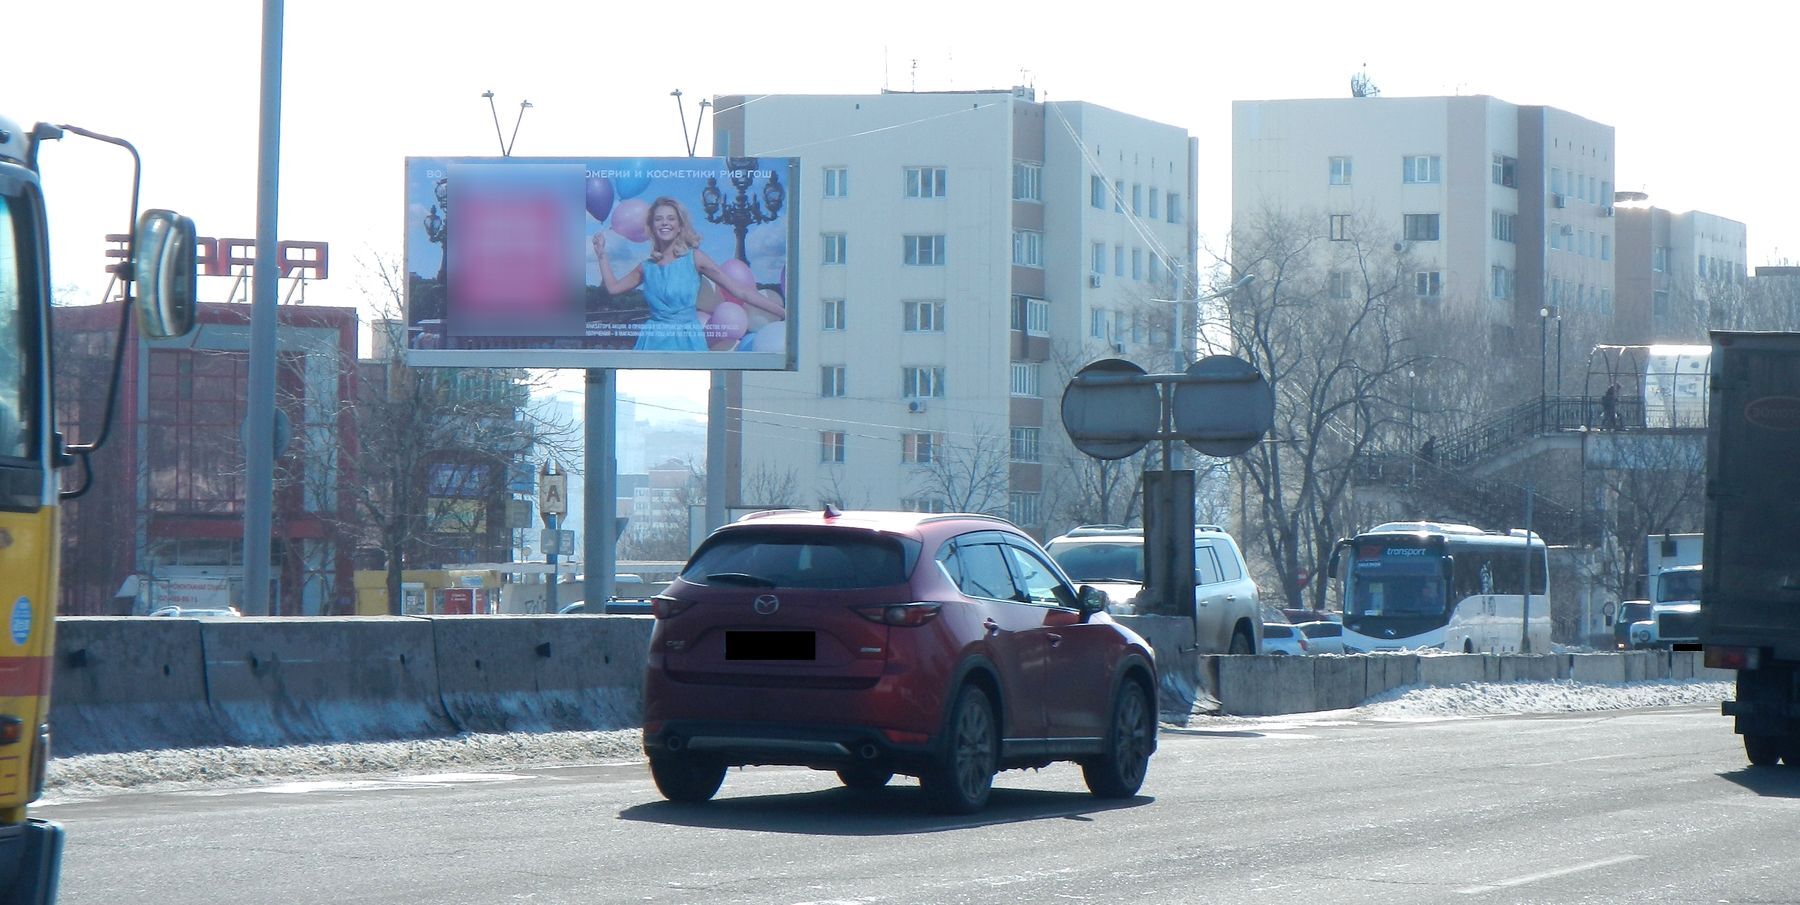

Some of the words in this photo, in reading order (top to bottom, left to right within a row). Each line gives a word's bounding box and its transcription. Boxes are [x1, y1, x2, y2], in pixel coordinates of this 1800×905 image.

[634, 169, 643, 178] И
[646, 169, 716, 179] КОСМЕТИКИ
[719, 169, 743, 179] РИВ
[747, 169, 772, 179] ГОШ
[1751, 407, 1800, 419] ЗОЛОТ
[1386, 547, 1426, 558] transport
